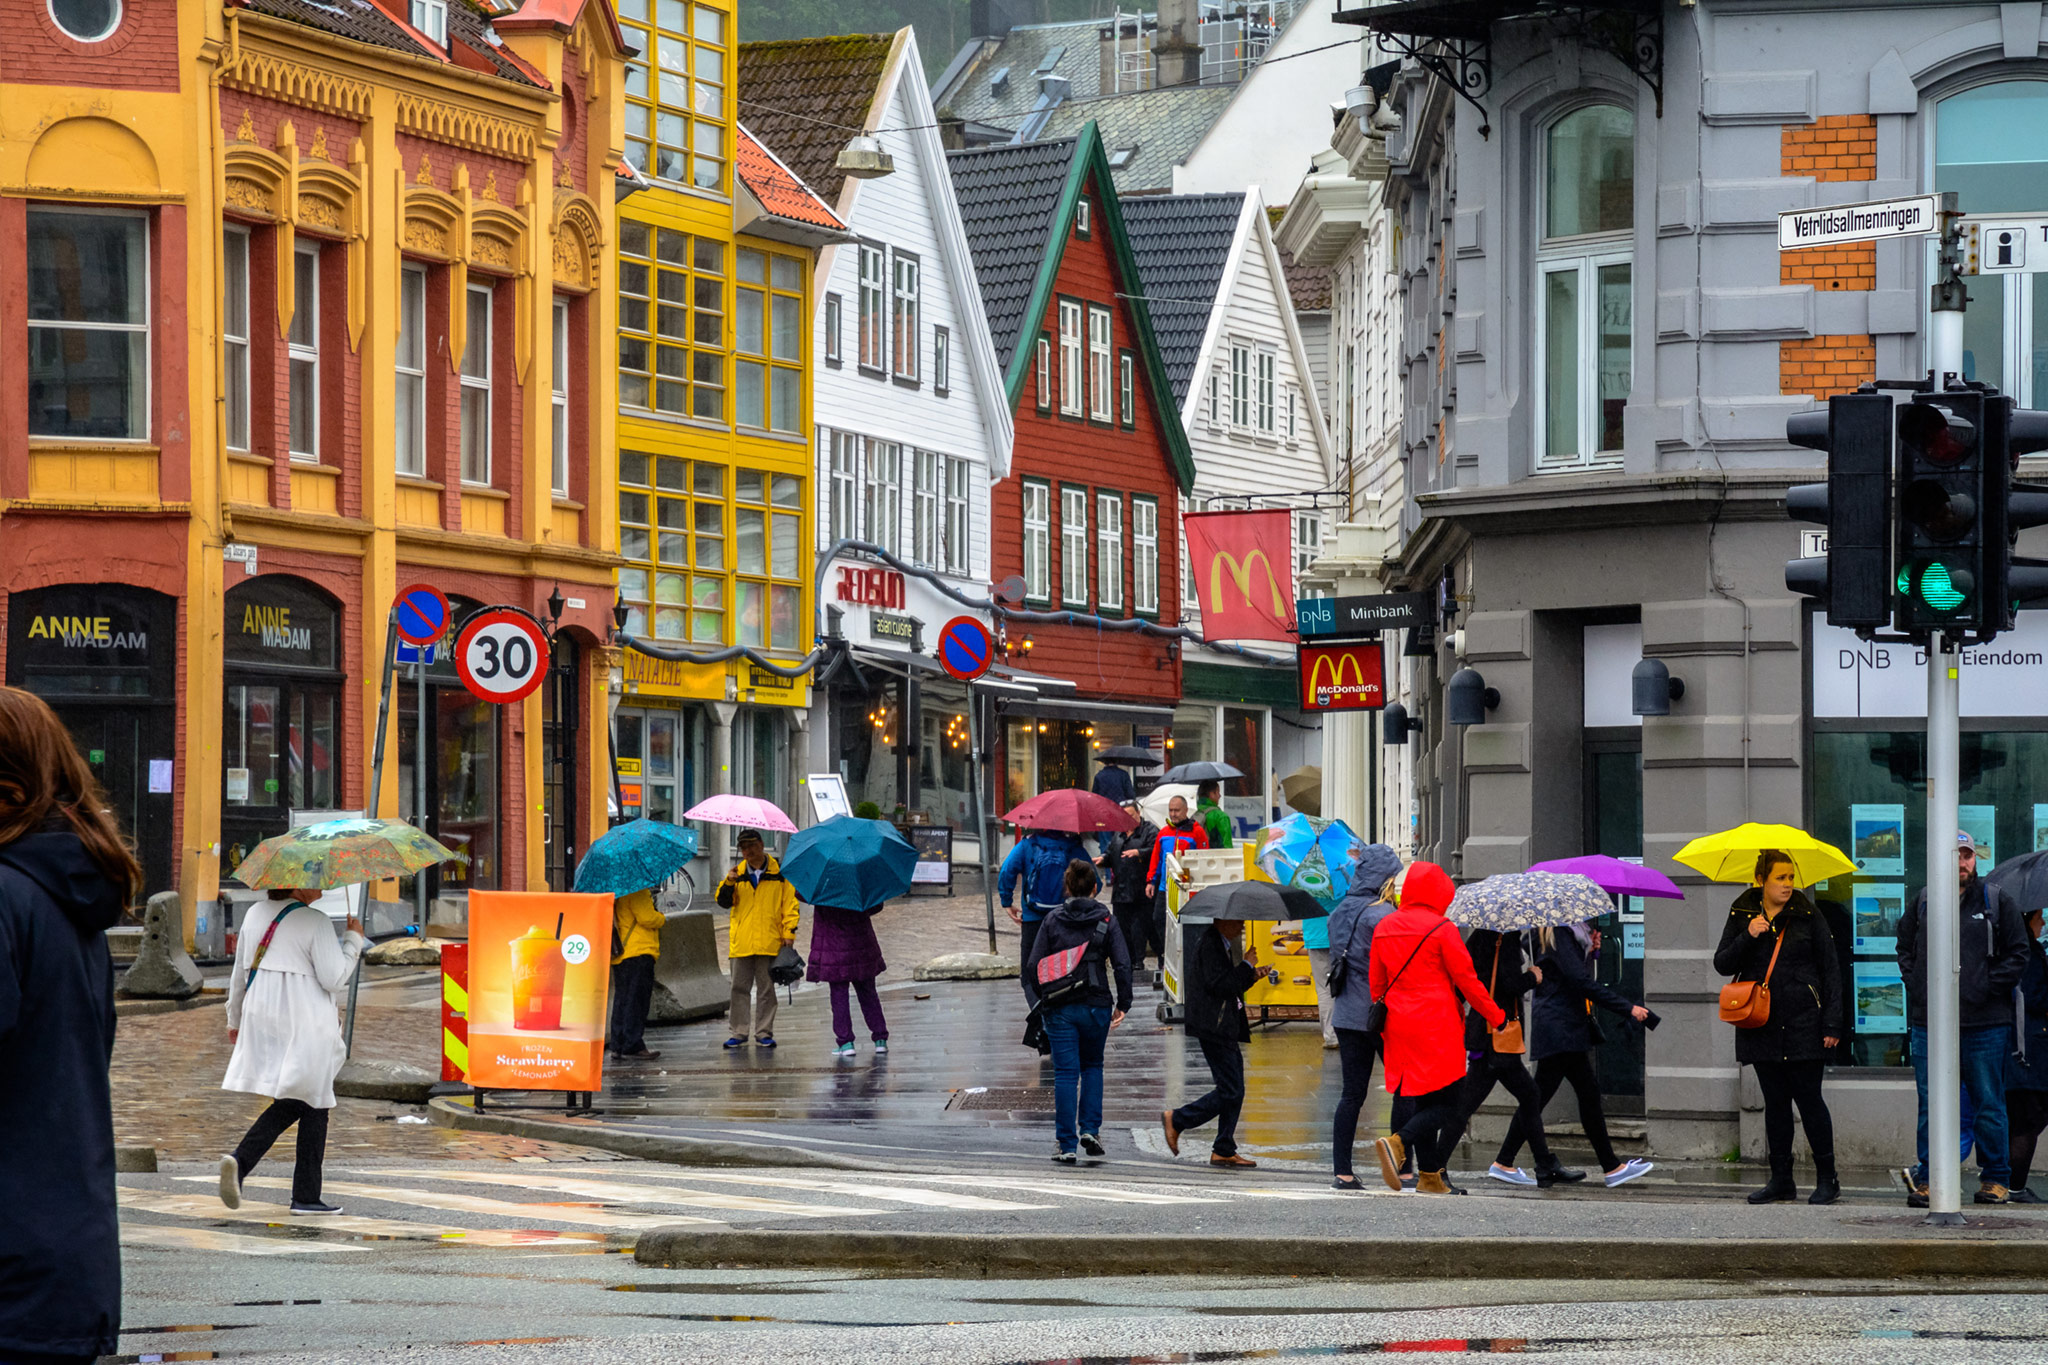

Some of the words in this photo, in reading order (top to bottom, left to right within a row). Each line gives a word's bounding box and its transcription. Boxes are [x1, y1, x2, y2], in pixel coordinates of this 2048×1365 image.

[1794, 206, 1920, 238] Vetrlidsallmenningen
[243, 604, 290, 637] ANNE
[1350, 604, 1413, 620] Minibank
[28, 615, 111, 639] ANNE
[877, 616, 892, 634] asian
[893, 618, 912, 638] cuisine
[63, 631, 146, 649] MADAM
[263, 625, 311, 650] MADAM
[475, 635, 532, 679] 30
[1963, 649, 2043, 666] Eiendom
[629, 653, 682, 687] NATALIE
[1317, 684, 1379, 695] McDonald's
[521, 1044, 553, 1053] FROZEN
[496, 1053, 576, 1071] Strawberry
[513, 1069, 558, 1079] LEMONADE
